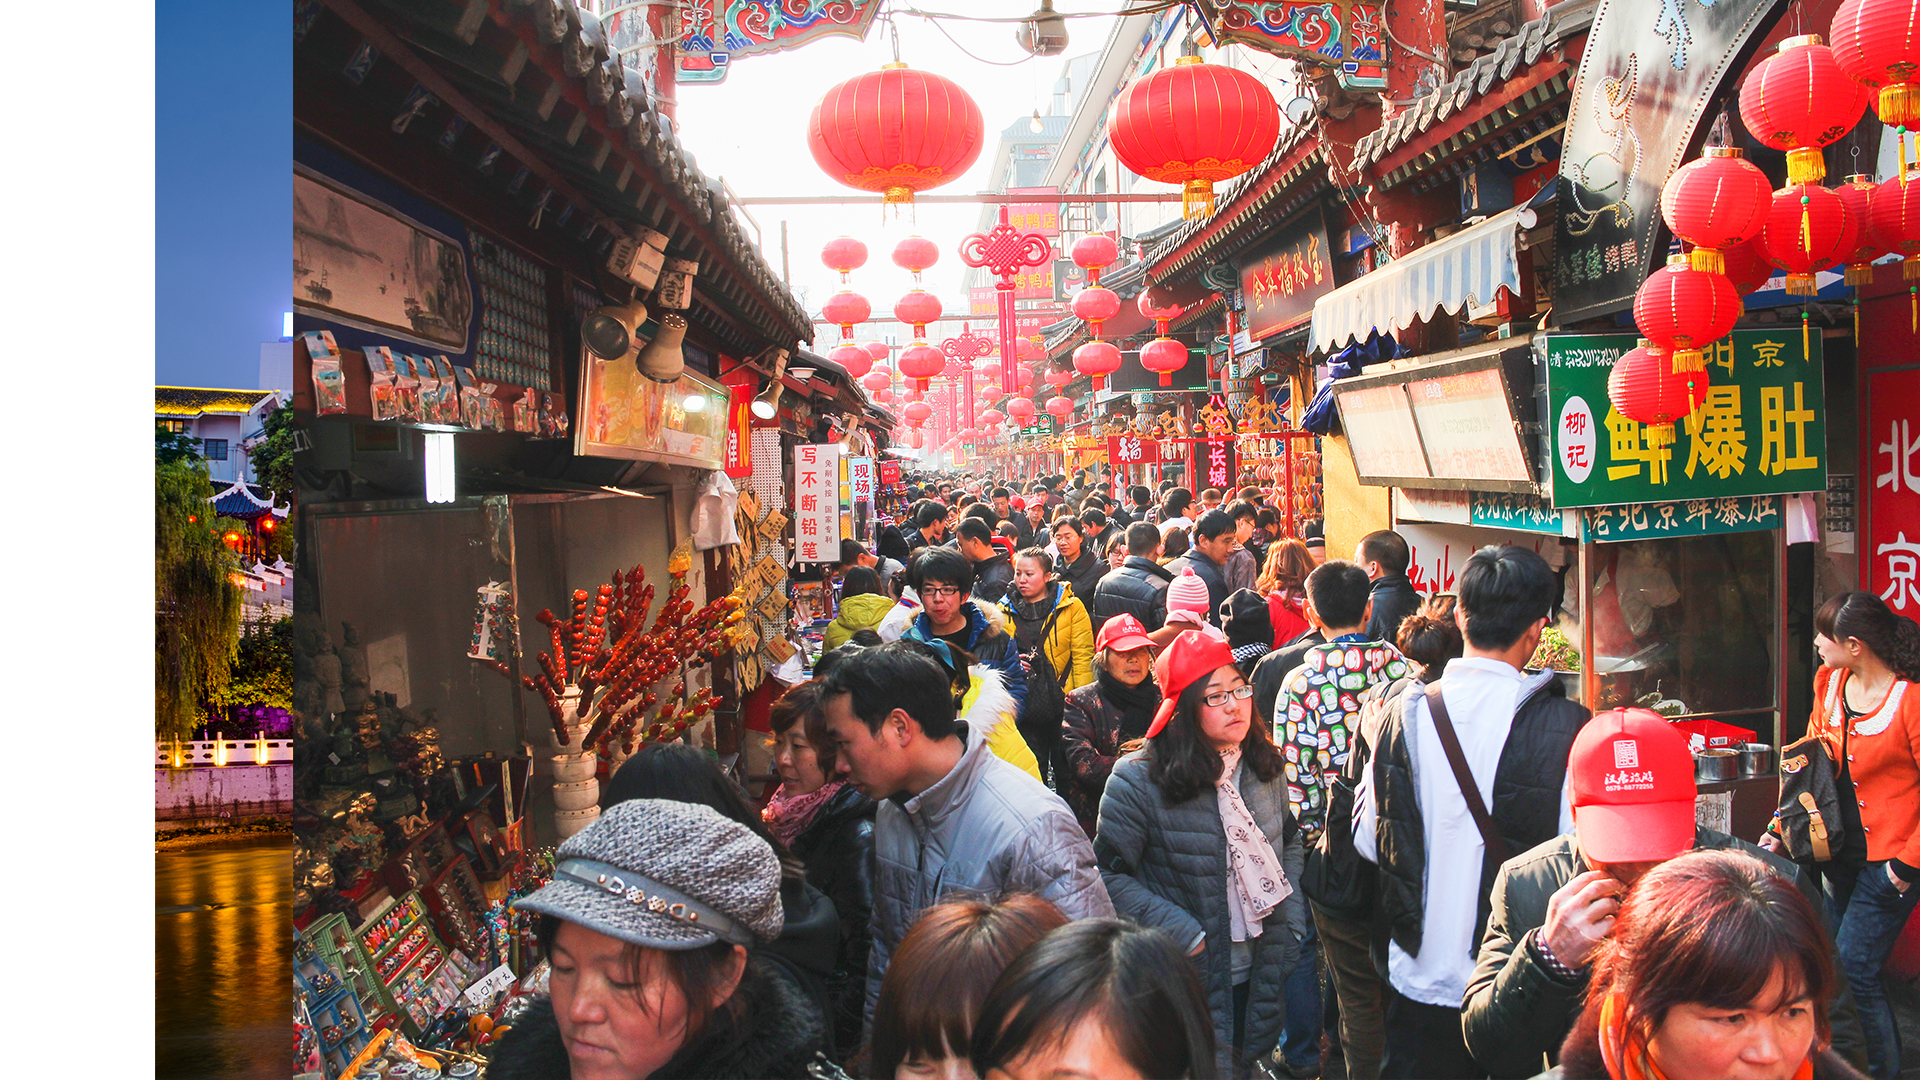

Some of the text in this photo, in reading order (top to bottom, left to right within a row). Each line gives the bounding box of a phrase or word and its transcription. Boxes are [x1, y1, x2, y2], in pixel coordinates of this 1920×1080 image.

[1010, 212, 1056, 230] 烤鸭店
[737, 402, 749, 467] 10
[1565, 411, 1589, 469] 柳记
[801, 447, 818, 559] 写不断铅笔
[824, 505, 833, 544] 国家专利
[1585, 496, 1777, 536] 老北京鲜爆肚
